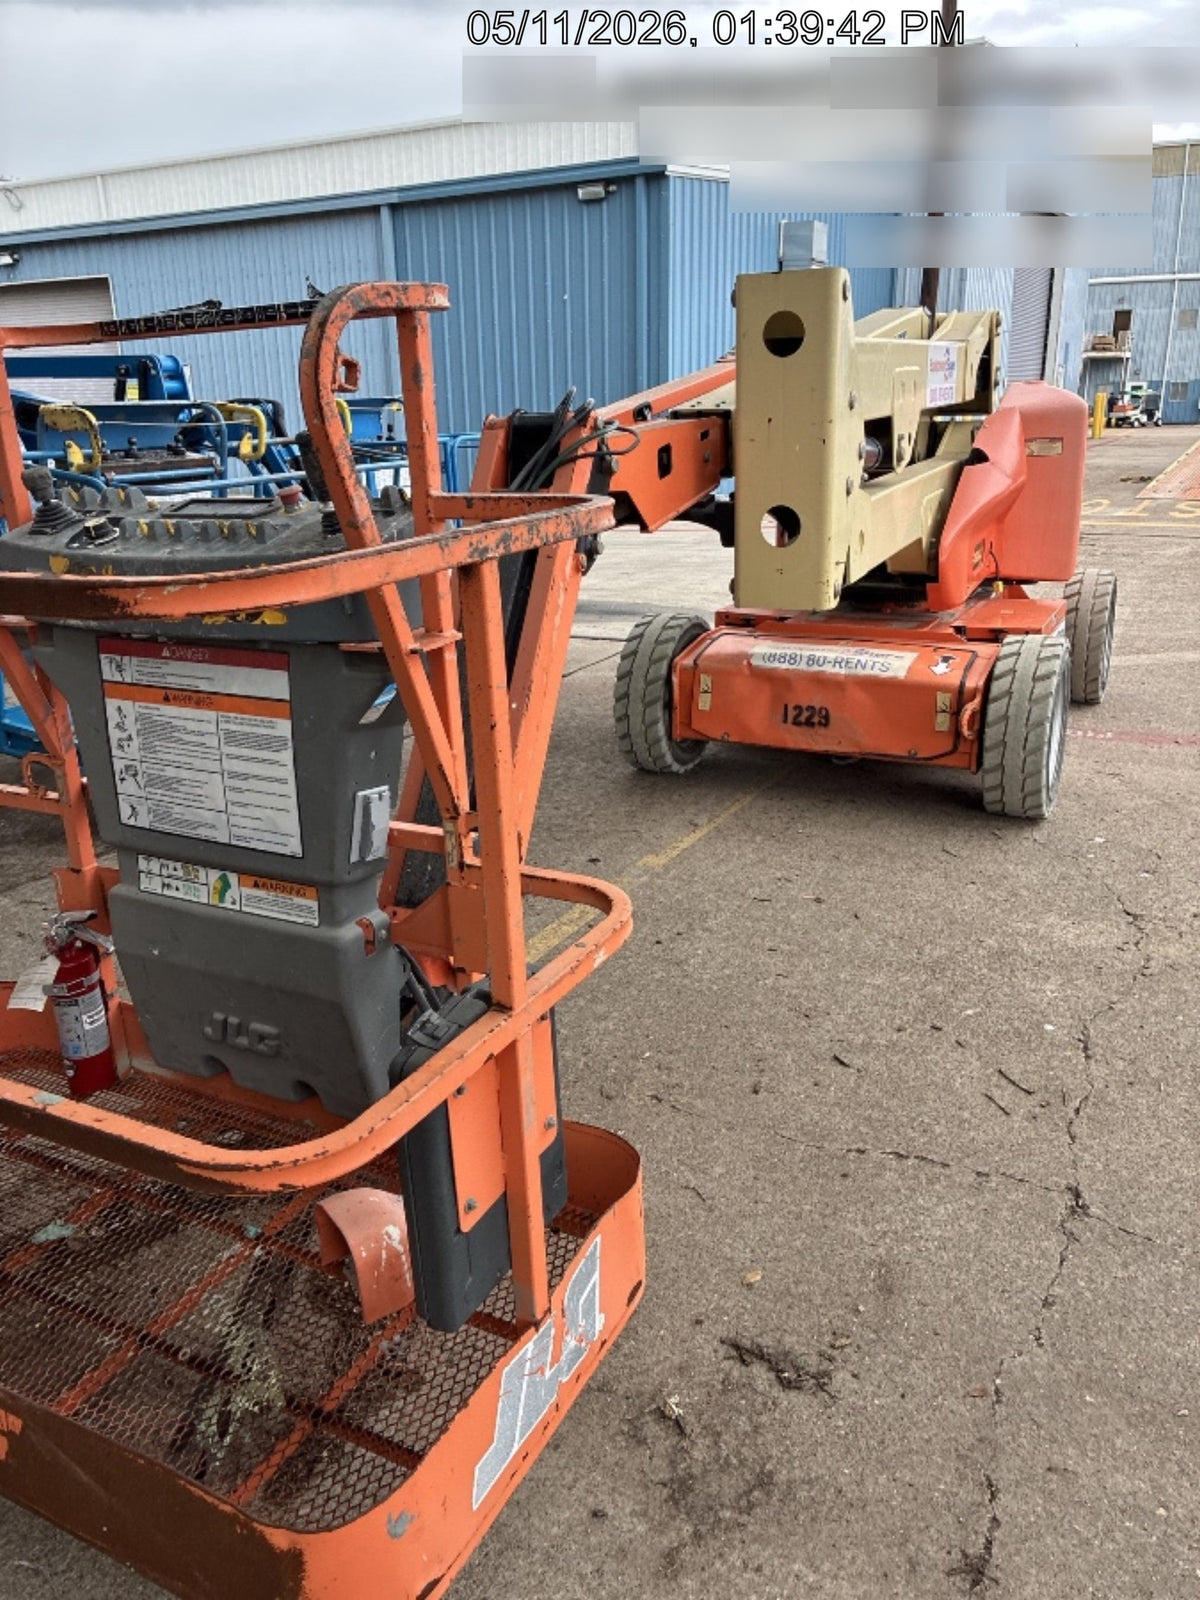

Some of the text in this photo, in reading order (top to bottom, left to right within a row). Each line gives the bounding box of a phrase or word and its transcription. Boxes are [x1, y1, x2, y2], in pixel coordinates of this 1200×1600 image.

[170, 646, 209, 661] DANGER
[761, 651, 892, 674] (888) 80-RENTS
[782, 703, 831, 729] 1229
[259, 879, 307, 898] WARNING
[203, 1010, 281, 1057] JLG
